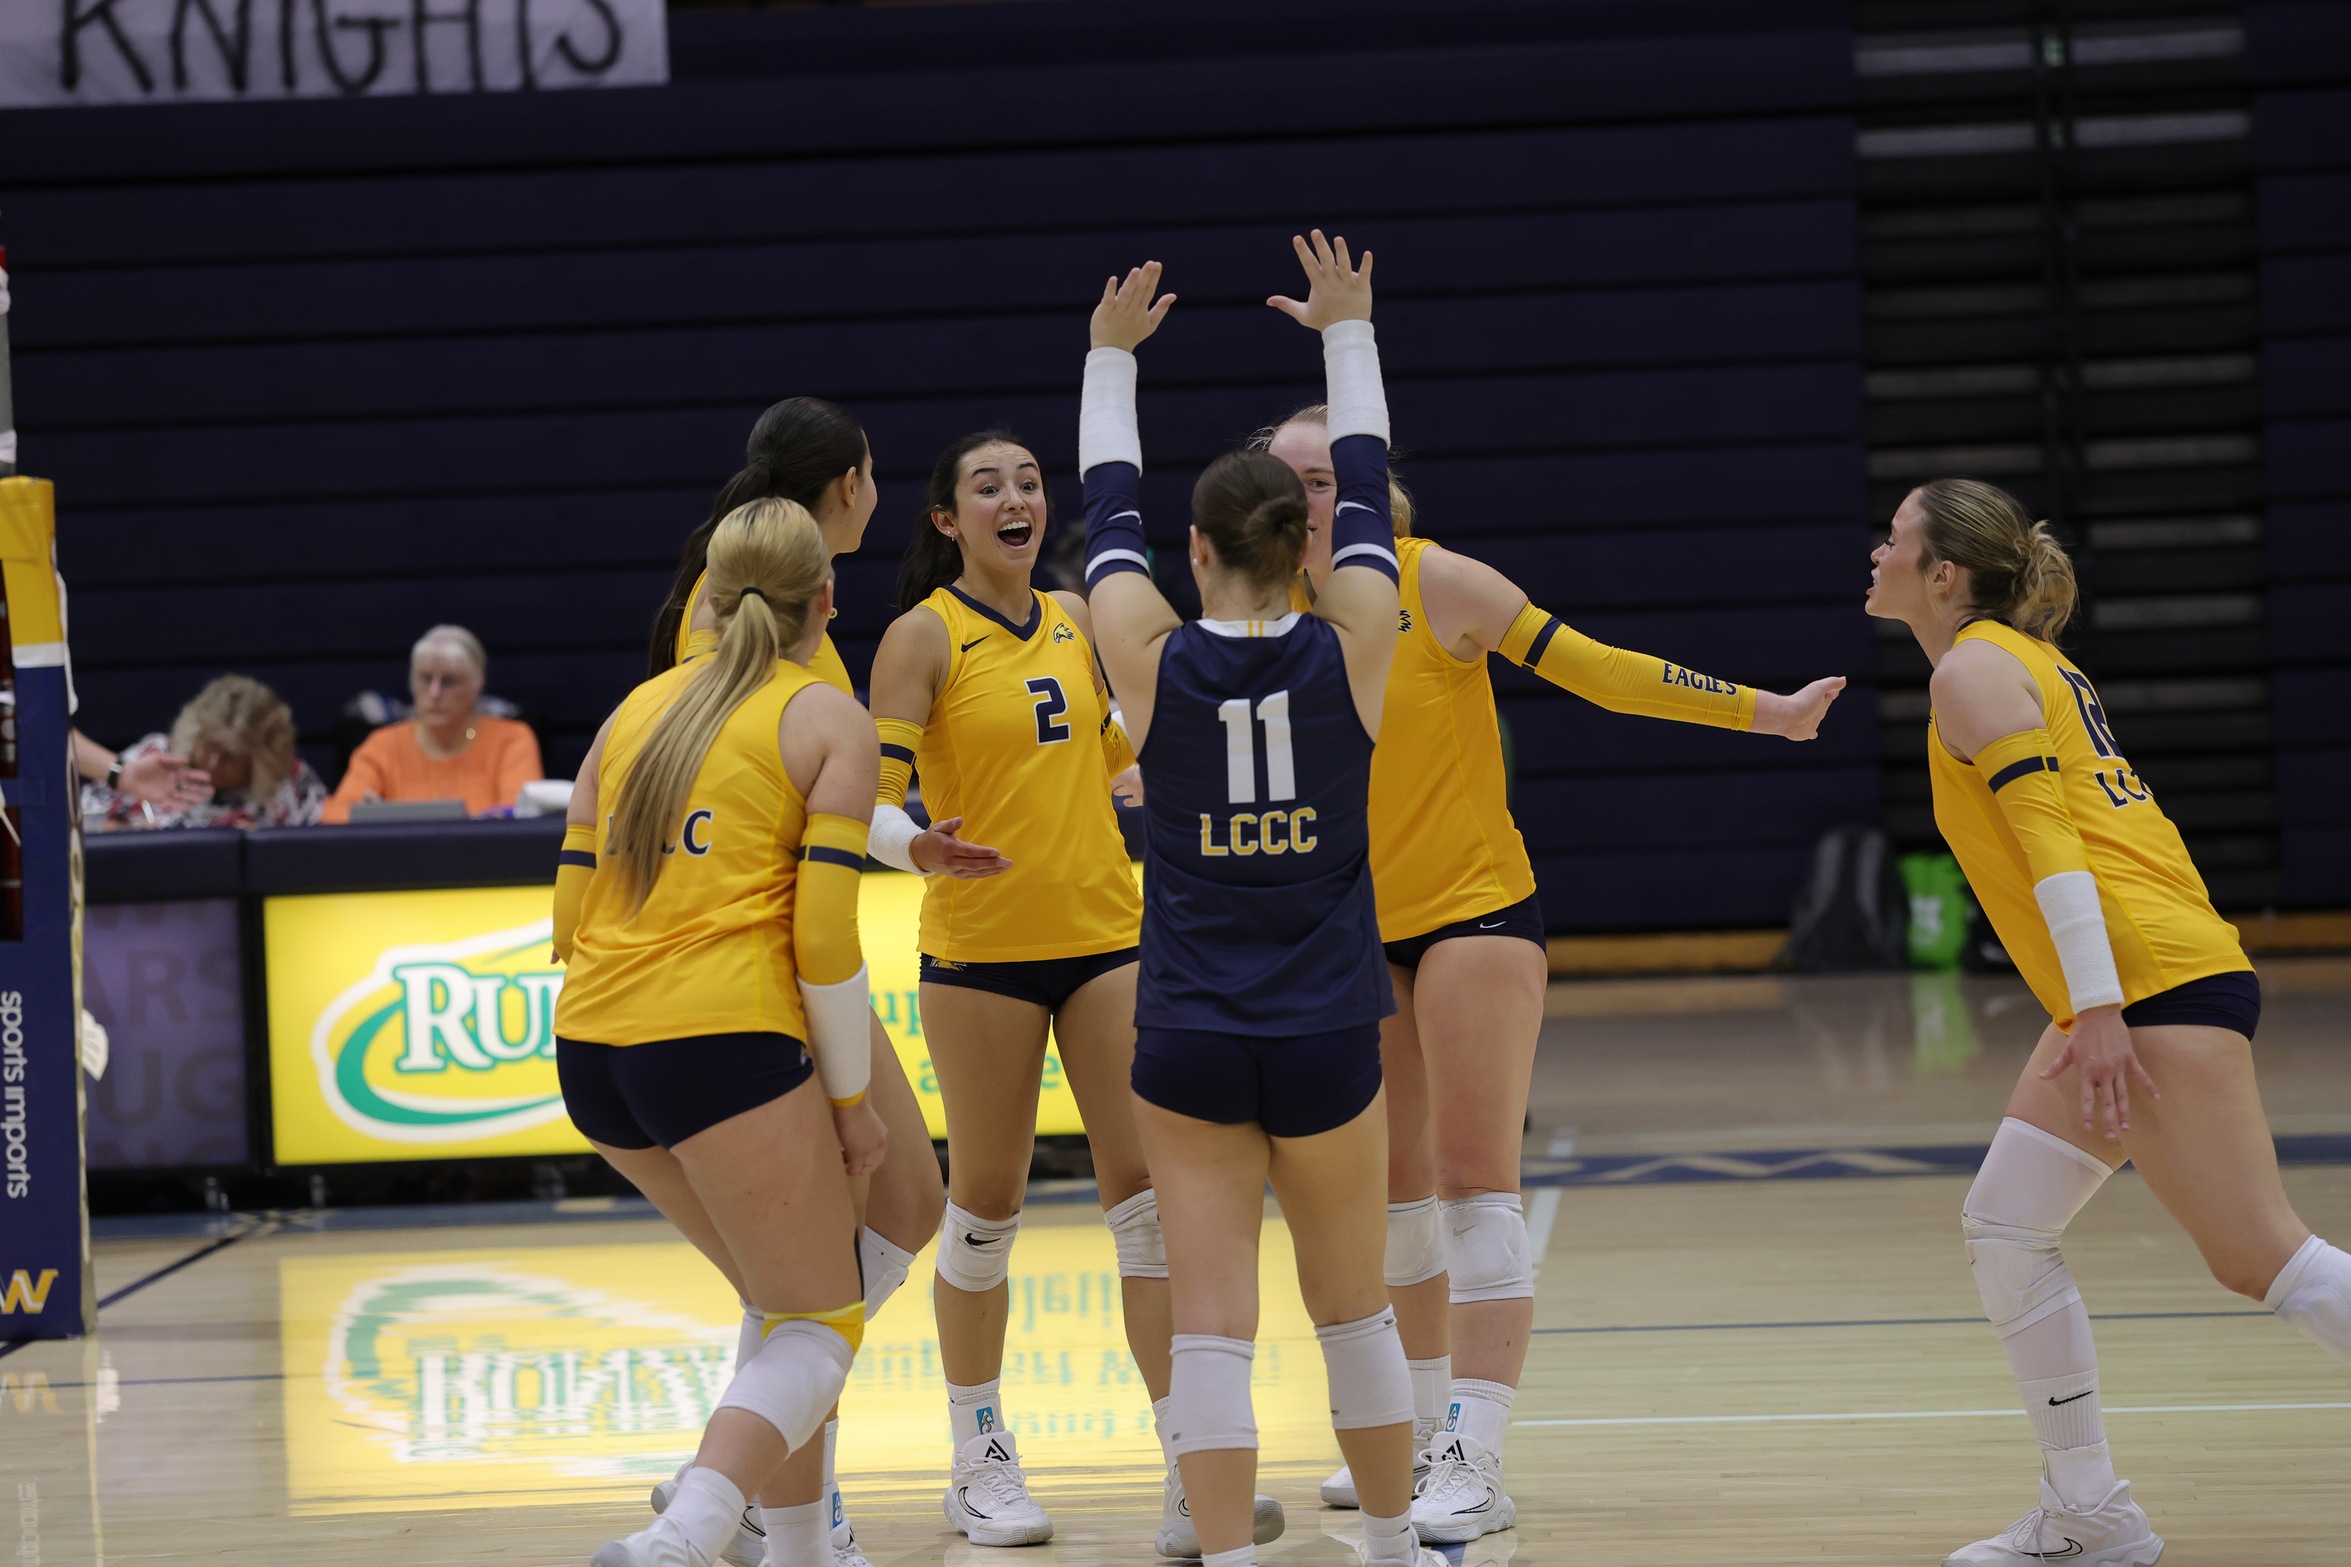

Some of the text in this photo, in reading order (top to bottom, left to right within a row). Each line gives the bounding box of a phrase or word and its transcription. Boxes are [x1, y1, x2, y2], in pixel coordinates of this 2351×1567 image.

[1023, 675, 1071, 746] 2
[1661, 661, 1738, 697] EAGLES
[1217, 689, 1296, 804] 11
[1200, 806, 1318, 857] LCCC
[0, 990, 31, 1199] sports imports
